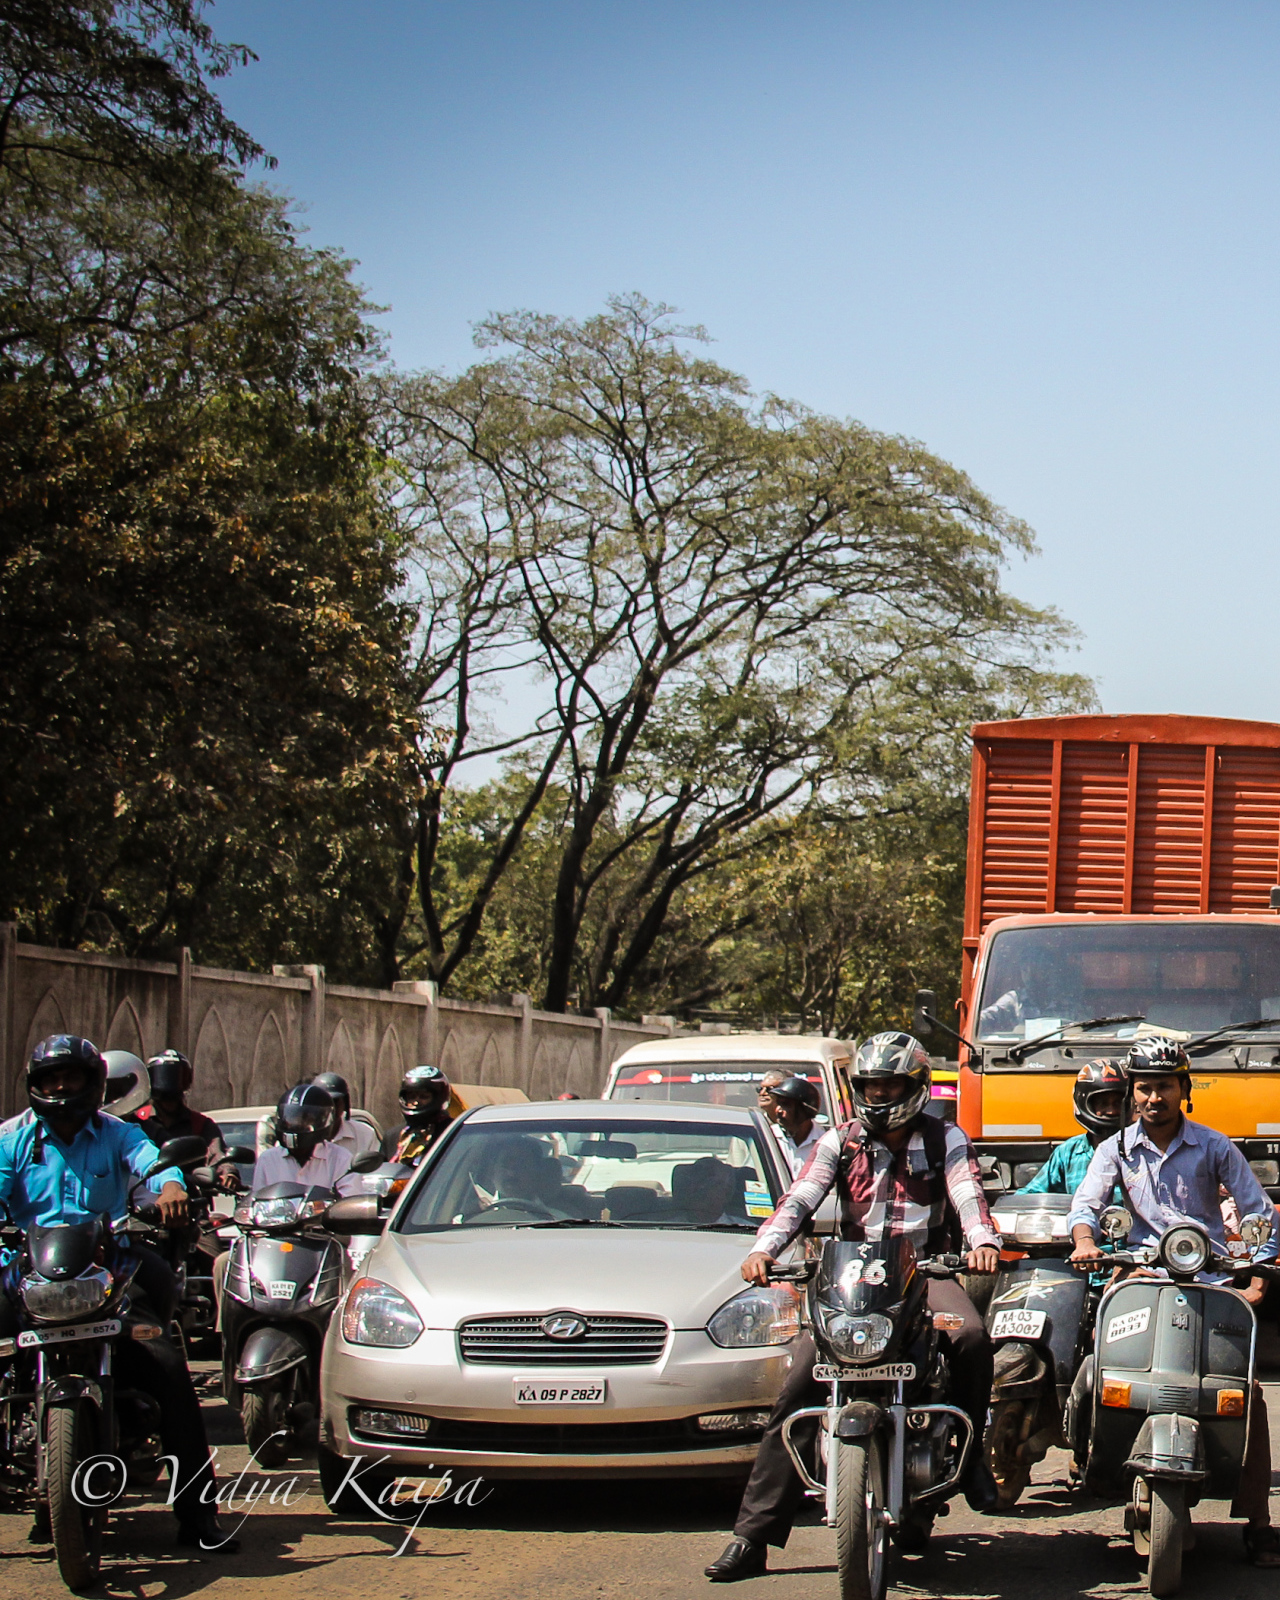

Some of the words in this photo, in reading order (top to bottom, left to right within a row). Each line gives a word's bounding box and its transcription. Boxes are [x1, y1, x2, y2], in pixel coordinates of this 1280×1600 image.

[22, 1335, 36, 1344] KA
[61, 1329, 76, 1337] HQ
[93, 1324, 116, 1334] 6574
[519, 1389, 537, 1401] KA
[540, 1389, 557, 1401] 09
[560, 1389, 569, 1401] P
[571, 1389, 602, 1401] 2827
